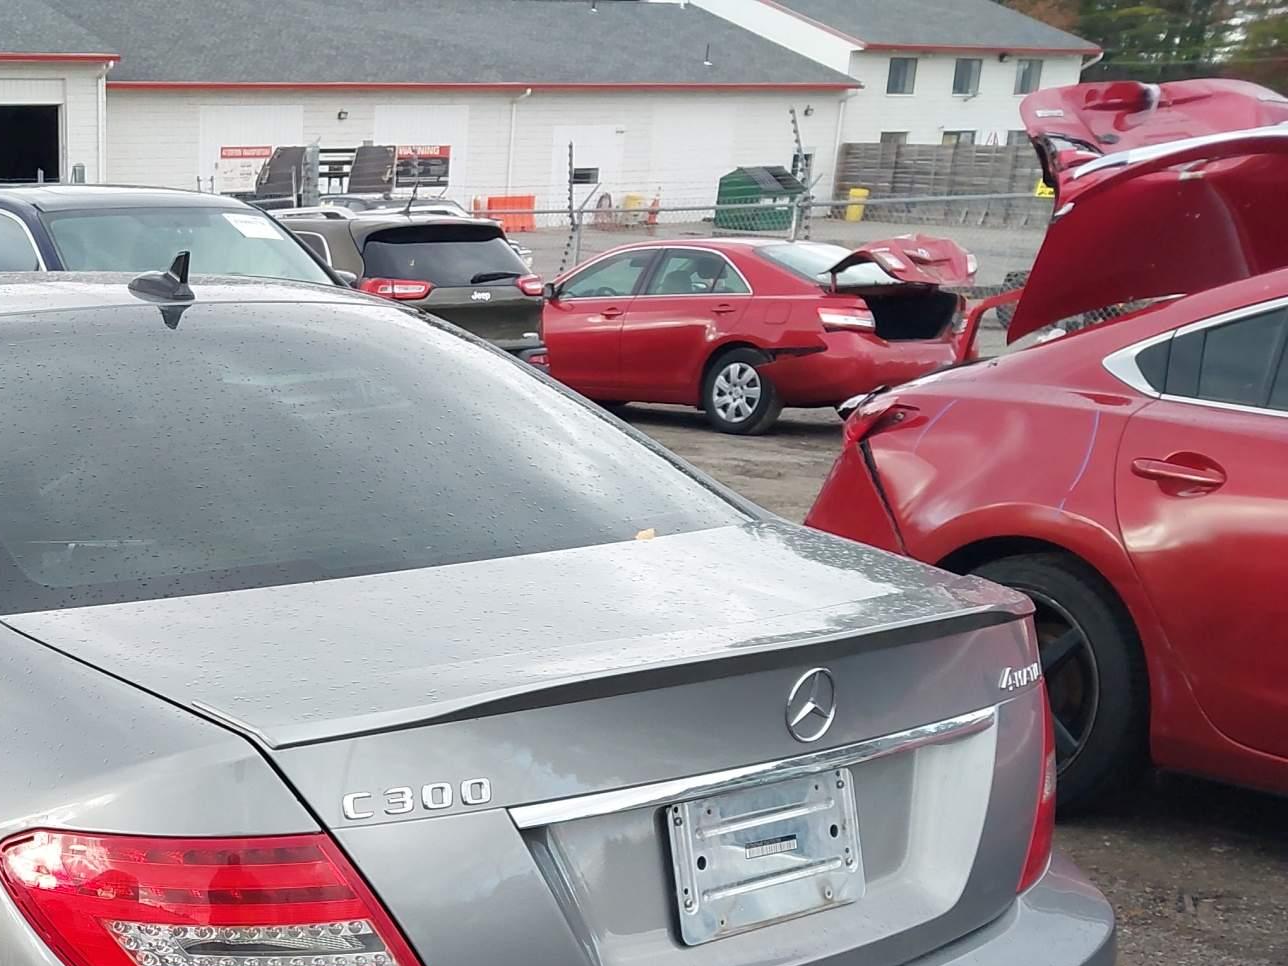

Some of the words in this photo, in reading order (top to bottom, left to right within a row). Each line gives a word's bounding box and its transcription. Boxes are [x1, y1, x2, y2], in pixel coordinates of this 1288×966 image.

[471, 291, 491, 301] Jeep
[342, 791, 375, 820] C
[383, 777, 492, 815] 300
